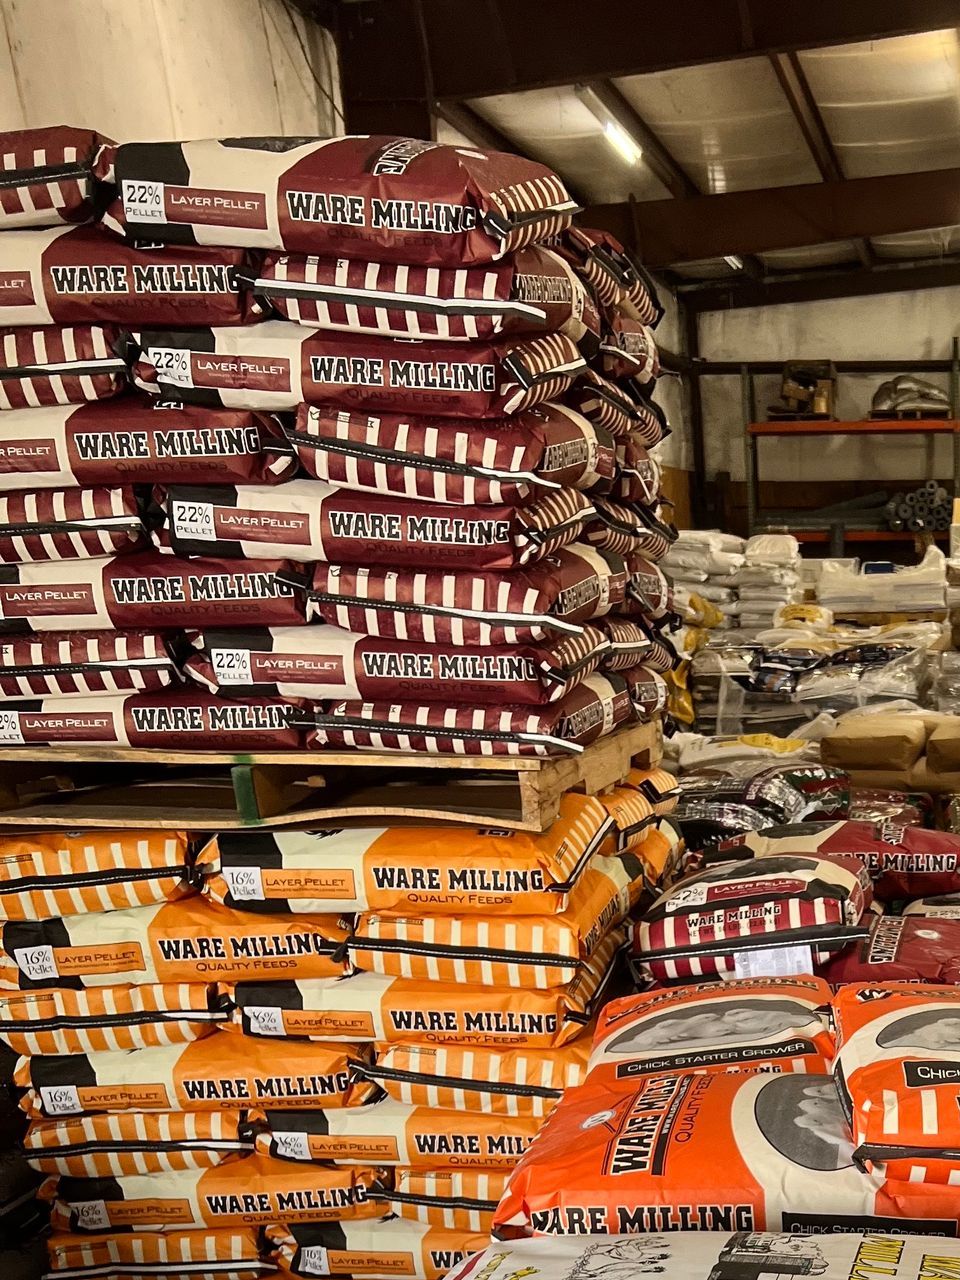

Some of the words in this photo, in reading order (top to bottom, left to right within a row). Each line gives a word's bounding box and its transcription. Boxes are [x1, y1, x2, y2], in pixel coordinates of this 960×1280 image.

[126, 184, 161, 205] 22%
[171, 194, 211, 208] LAYER
[214, 197, 260, 211] PELLET
[125, 207, 164, 219] PELLET
[286, 192, 365, 226] WARE
[372, 199, 477, 233] MILLING
[51, 265, 130, 294] WARE
[151, 351, 188, 371] 22%
[197, 360, 237, 374] LAYER
[239, 362, 286, 376] PELLET
[310, 357, 385, 387] WARE
[389, 360, 496, 392] MILLING
[73, 431, 150, 460] WARE
[153, 427, 260, 460] MILLING
[176, 505, 211, 525] 22%
[220, 513, 259, 527] LAYER
[260, 517, 305, 530] PELLET
[328, 511, 402, 540] WARE
[407, 515, 510, 546] MILLING
[5, 591, 42, 602] LAYER
[45, 590, 89, 602] PELLET
[110, 576, 186, 604] WARE
[215, 652, 248, 670] 22%
[256, 658, 294, 670] LAYER
[295, 659, 339, 672] PELLET
[362, 652, 434, 679] WARE
[439, 653, 540, 682] MILLING
[25, 718, 64, 729] LAYER
[65, 718, 109, 729] PELLET
[131, 705, 204, 732] WARE
[883, 853, 957, 873] MILLING
[229, 871, 256, 886] 16%
[265, 878, 302, 888] LAYER
[303, 877, 346, 888] PELLET
[371, 866, 442, 891] WARE
[448, 868, 546, 894] MILLING
[407, 892, 466, 906] QUALITY
[468, 894, 514, 906] FEEDS
[686, 912, 726, 930] WARE
[727, 905, 781, 926] MILLING
[22, 951, 51, 965] 16%
[57, 953, 94, 965] LAYER
[94, 951, 138, 963] PELLET
[158, 936, 227, 962] WARE
[195, 961, 251, 974] QUALITY
[253, 959, 299, 971] FEEDS
[286, 1018, 323, 1028] LAYER
[389, 1010, 459, 1034] WARE
[463, 1010, 558, 1034] MILLING
[426, 1032, 482, 1045] QUALITY
[484, 1033, 529, 1045] FEEDS
[627, 1059, 671, 1073] CHICK
[675, 1050, 739, 1066] STARTER
[742, 1042, 806, 1058] GROWER
[183, 1078, 250, 1101] WARE
[253, 1072, 350, 1098] MILLING
[81, 1093, 117, 1103] LAYER
[119, 1091, 161, 1102] PELLET
[311, 1142, 347, 1152] LAYER
[348, 1142, 390, 1152] PELLET
[414, 1133, 481, 1156] WARE
[610, 1113, 664, 1176] WARE
[448, 1156, 502, 1166] QUALITY
[207, 1194, 271, 1216] WARE
[276, 1184, 368, 1210] MILLING
[530, 1204, 610, 1236] WARE
[616, 1204, 755, 1233] MILLING
[330, 1257, 367, 1268] LAYER
[368, 1258, 405, 1268] PELLET
